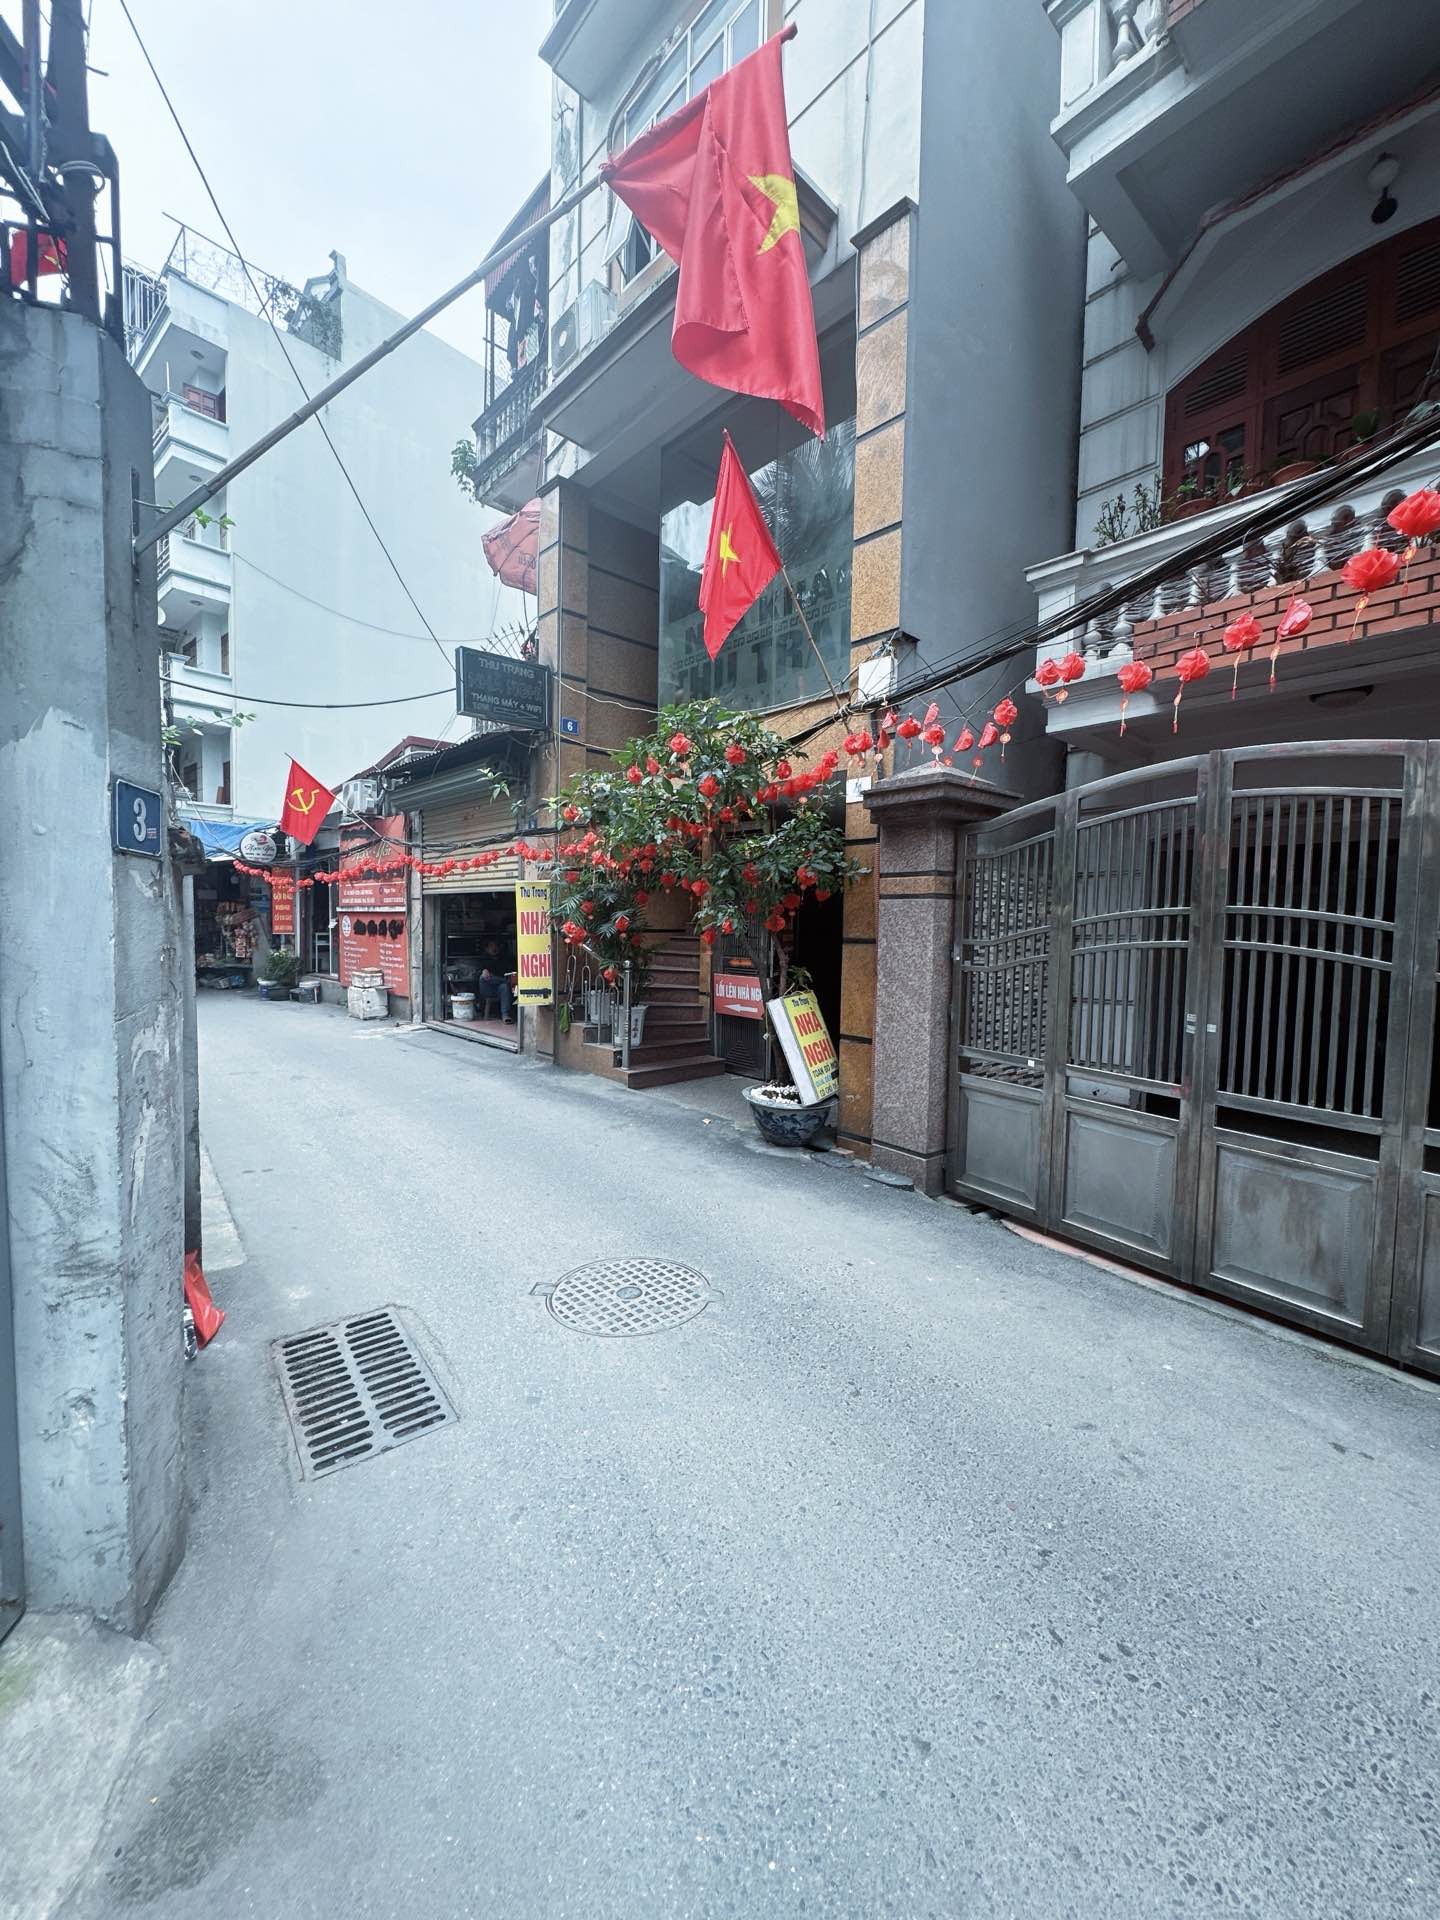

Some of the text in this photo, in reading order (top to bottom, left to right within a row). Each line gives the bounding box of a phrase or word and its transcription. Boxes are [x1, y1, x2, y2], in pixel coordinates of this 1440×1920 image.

[479, 657, 535, 679] THU TRANG
[471, 692, 500, 705] THANG
[567, 723, 573, 731] 6
[133, 797, 147, 842] 3
[520, 886, 548, 900] Thu Trang
[520, 906, 549, 934] NHÀ
[725, 982, 736, 999] LÊN
[737, 984, 750, 1000] NHÀ
[794, 1006, 823, 1037] NHÀ
[803, 1031, 834, 1067] NGHỈ
